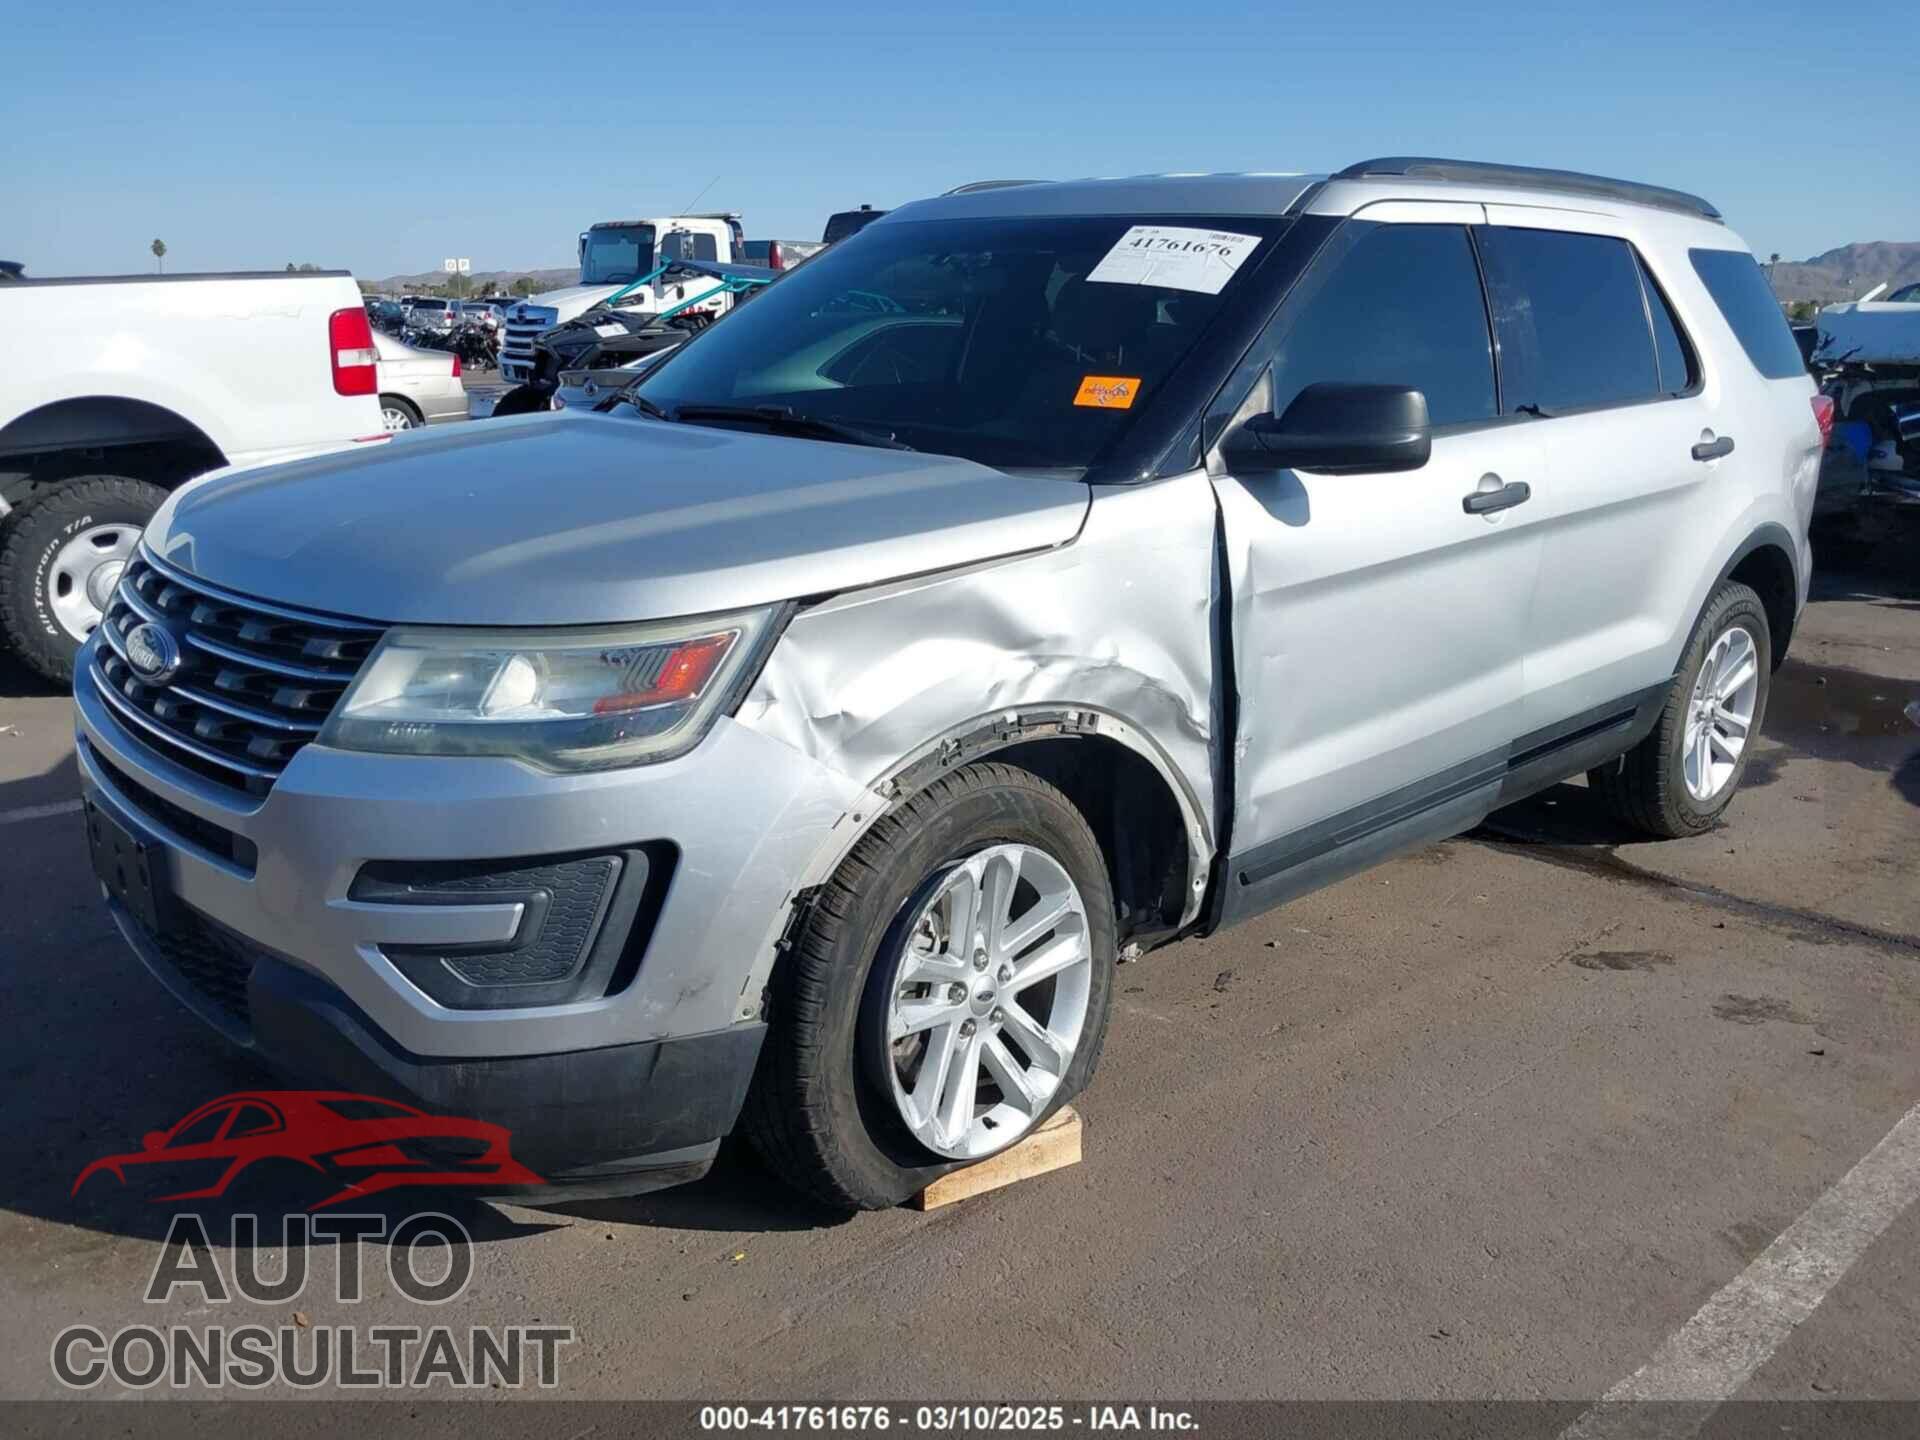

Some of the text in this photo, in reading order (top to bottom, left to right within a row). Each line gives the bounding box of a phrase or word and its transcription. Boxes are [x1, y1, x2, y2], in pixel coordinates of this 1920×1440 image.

[1128, 237, 1233, 258] 41761676
[34, 515, 93, 635] All-Terrain T/A
